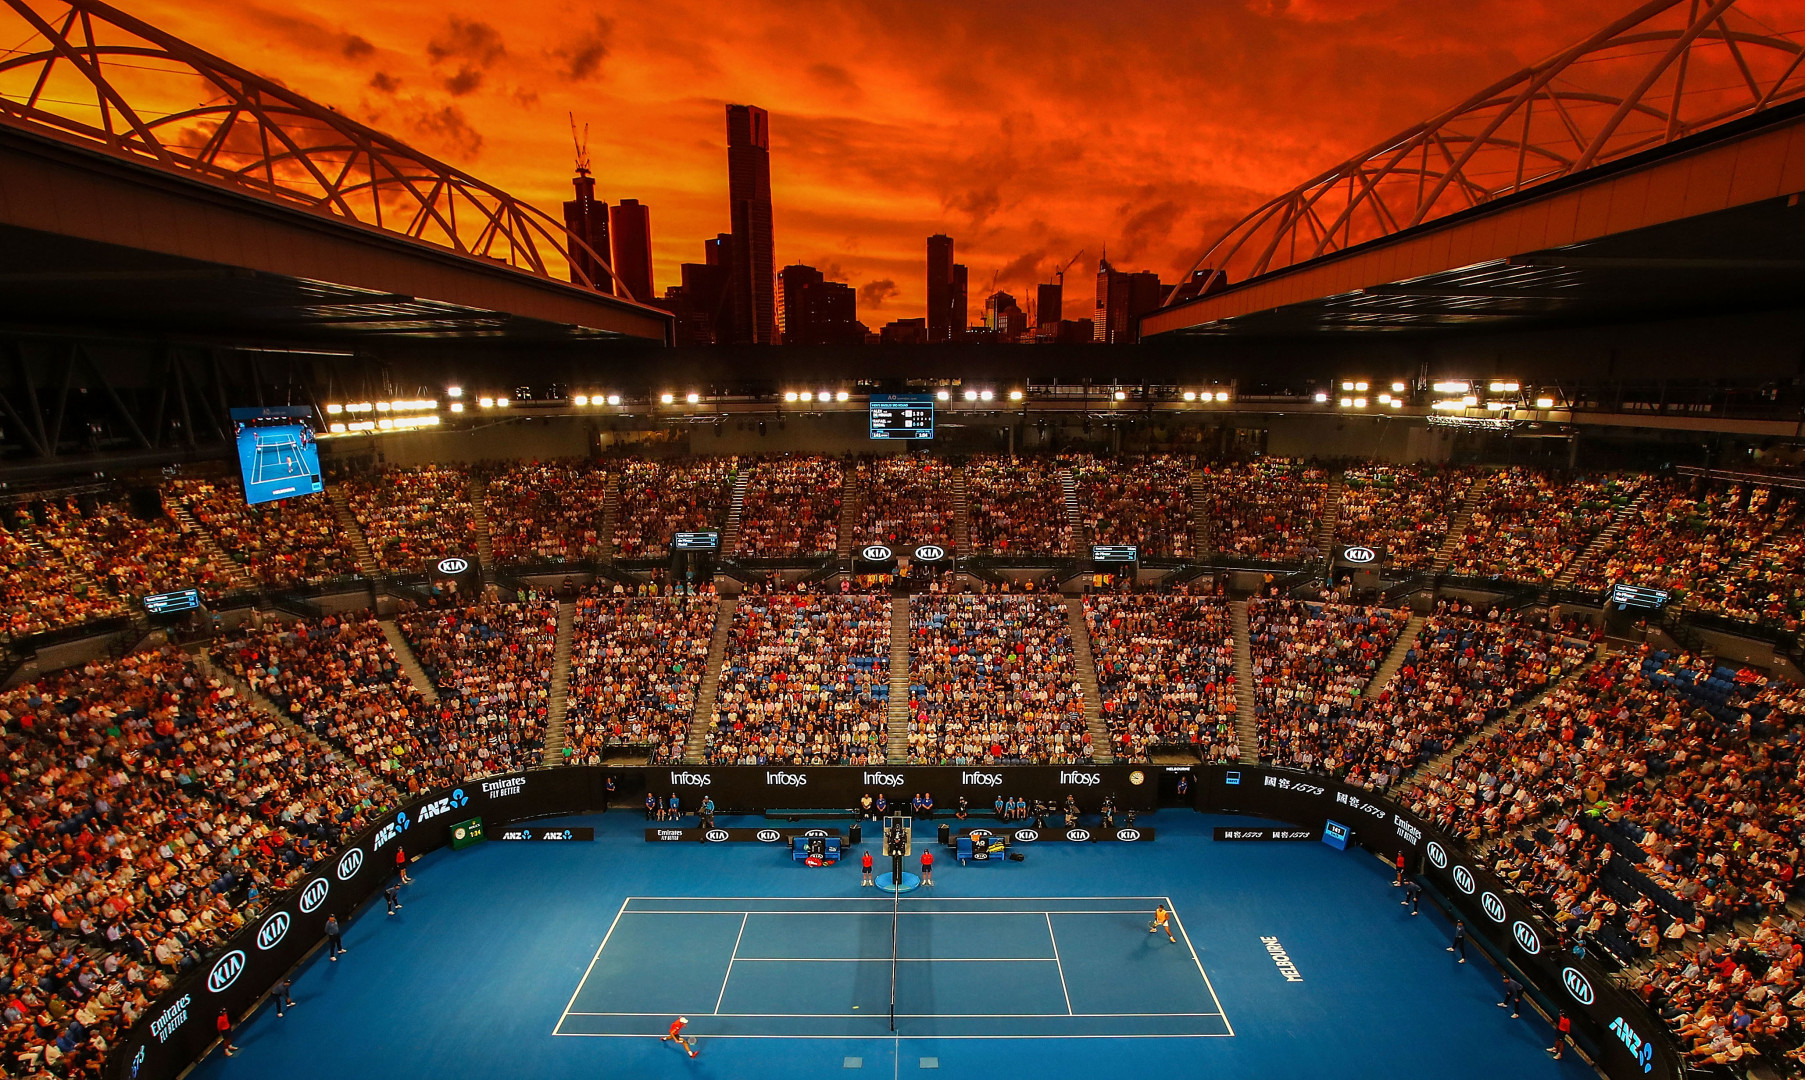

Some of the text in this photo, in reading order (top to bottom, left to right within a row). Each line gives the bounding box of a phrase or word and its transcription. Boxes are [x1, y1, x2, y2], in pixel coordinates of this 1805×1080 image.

[868, 548, 886, 558] KIA
[920, 548, 939, 558] KIA
[1349, 550, 1369, 559] KIA
[443, 561, 464, 571] KIA
[482, 777, 526, 793] Emirates
[671, 771, 711, 787] Infosys
[767, 771, 807, 787] Infosys
[863, 771, 904, 787] Infosys
[962, 771, 1003, 787] Infosys
[1060, 771, 1100, 787] Infosys
[490, 786, 521, 799] FLY BETTER
[418, 798, 451, 823] ANZ
[374, 822, 397, 851] ANZ
[502, 832, 522, 840] ANZ
[543, 832, 563, 840] ANZ
[1070, 831, 1086, 839] KIA
[1120, 831, 1136, 839] KIA
[1394, 814, 1422, 840] Emirates
[341, 853, 359, 877] KIA
[1429, 845, 1444, 865] KIA
[1456, 868, 1471, 892] KIA
[303, 882, 325, 909] KIA
[1484, 895, 1501, 920] KIA
[262, 915, 286, 946] KIA
[1517, 924, 1535, 951] KIA
[1260, 936, 1304, 982] MELBOURNE
[213, 955, 241, 989] KIA
[1567, 970, 1588, 1002] KIA
[150, 994, 191, 1037] Emirates
[168, 1010, 188, 1038] BETTER
[1608, 1016, 1642, 1059] ANZ
